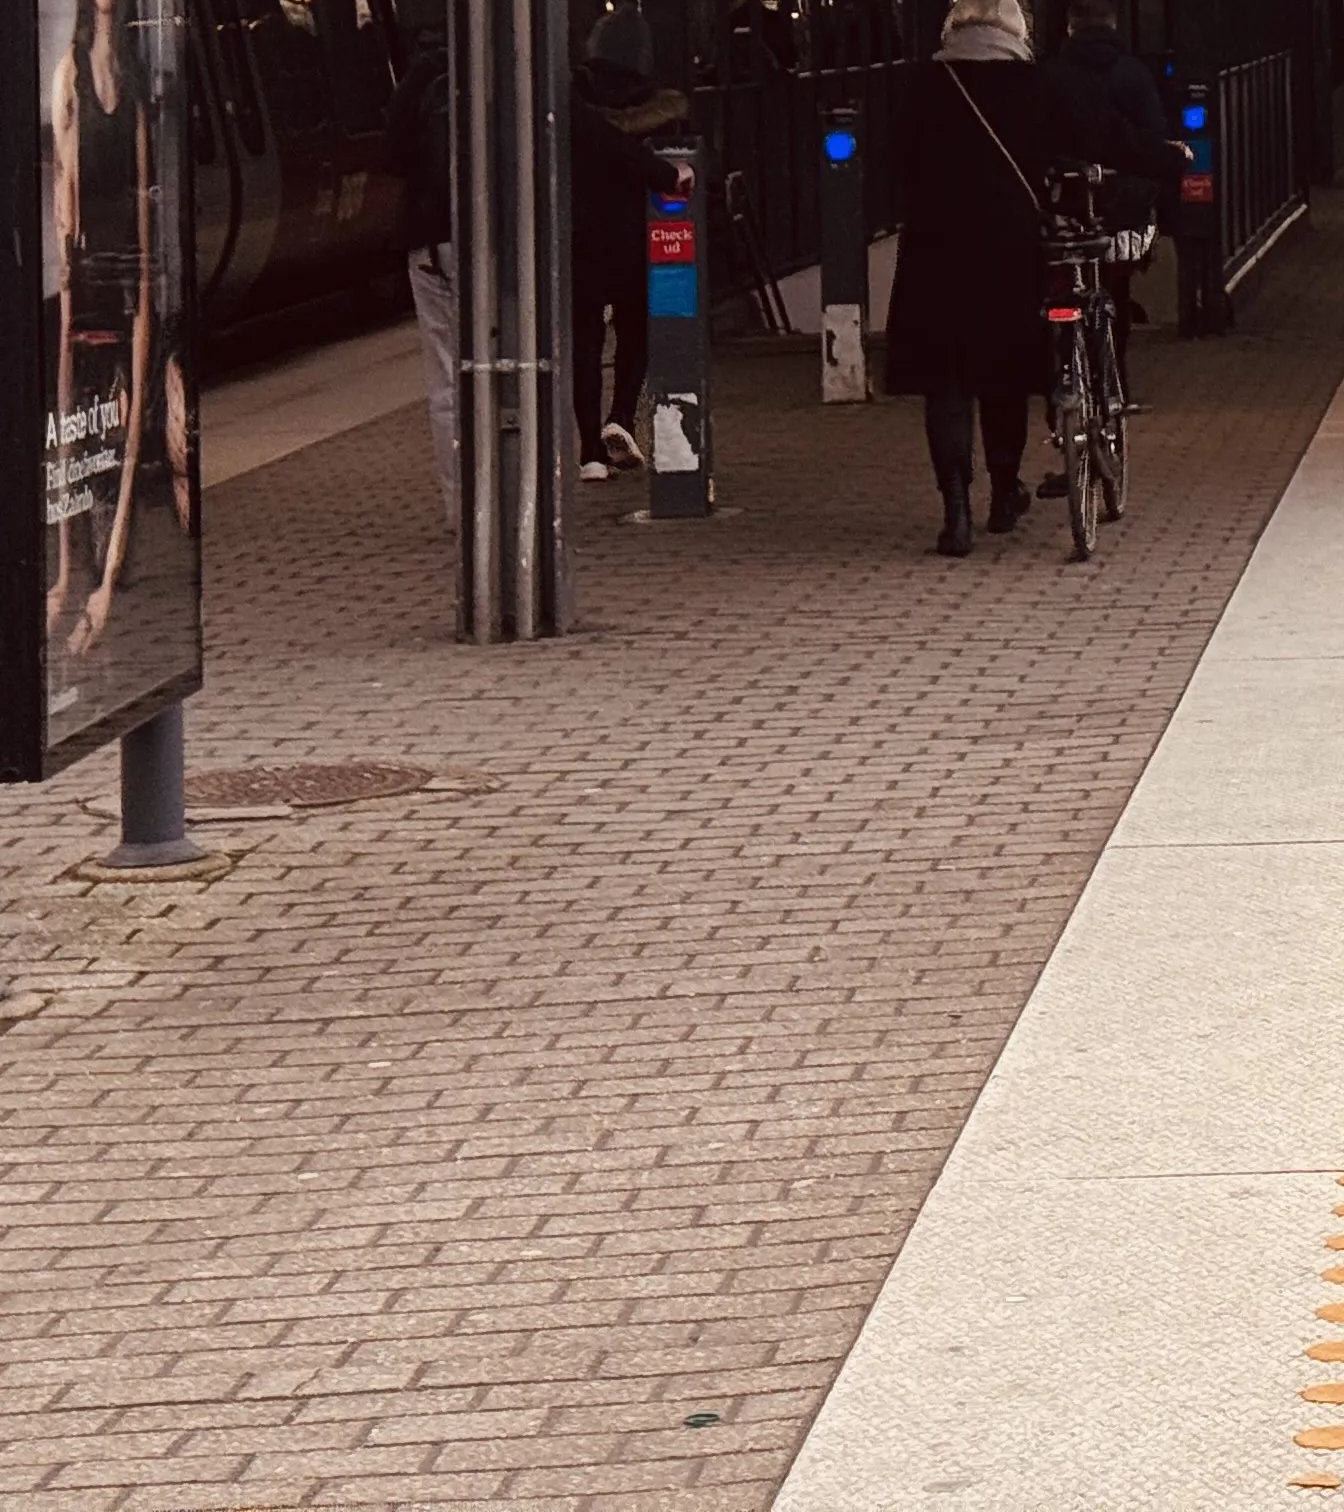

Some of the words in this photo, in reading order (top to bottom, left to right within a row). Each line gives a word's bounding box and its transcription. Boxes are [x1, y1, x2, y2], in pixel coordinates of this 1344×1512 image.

[651, 229, 693, 242] Check
[664, 242, 681, 254] ud
[46, 412, 57, 449] A
[60, 405, 87, 445] taste
[100, 398, 119, 441] you
